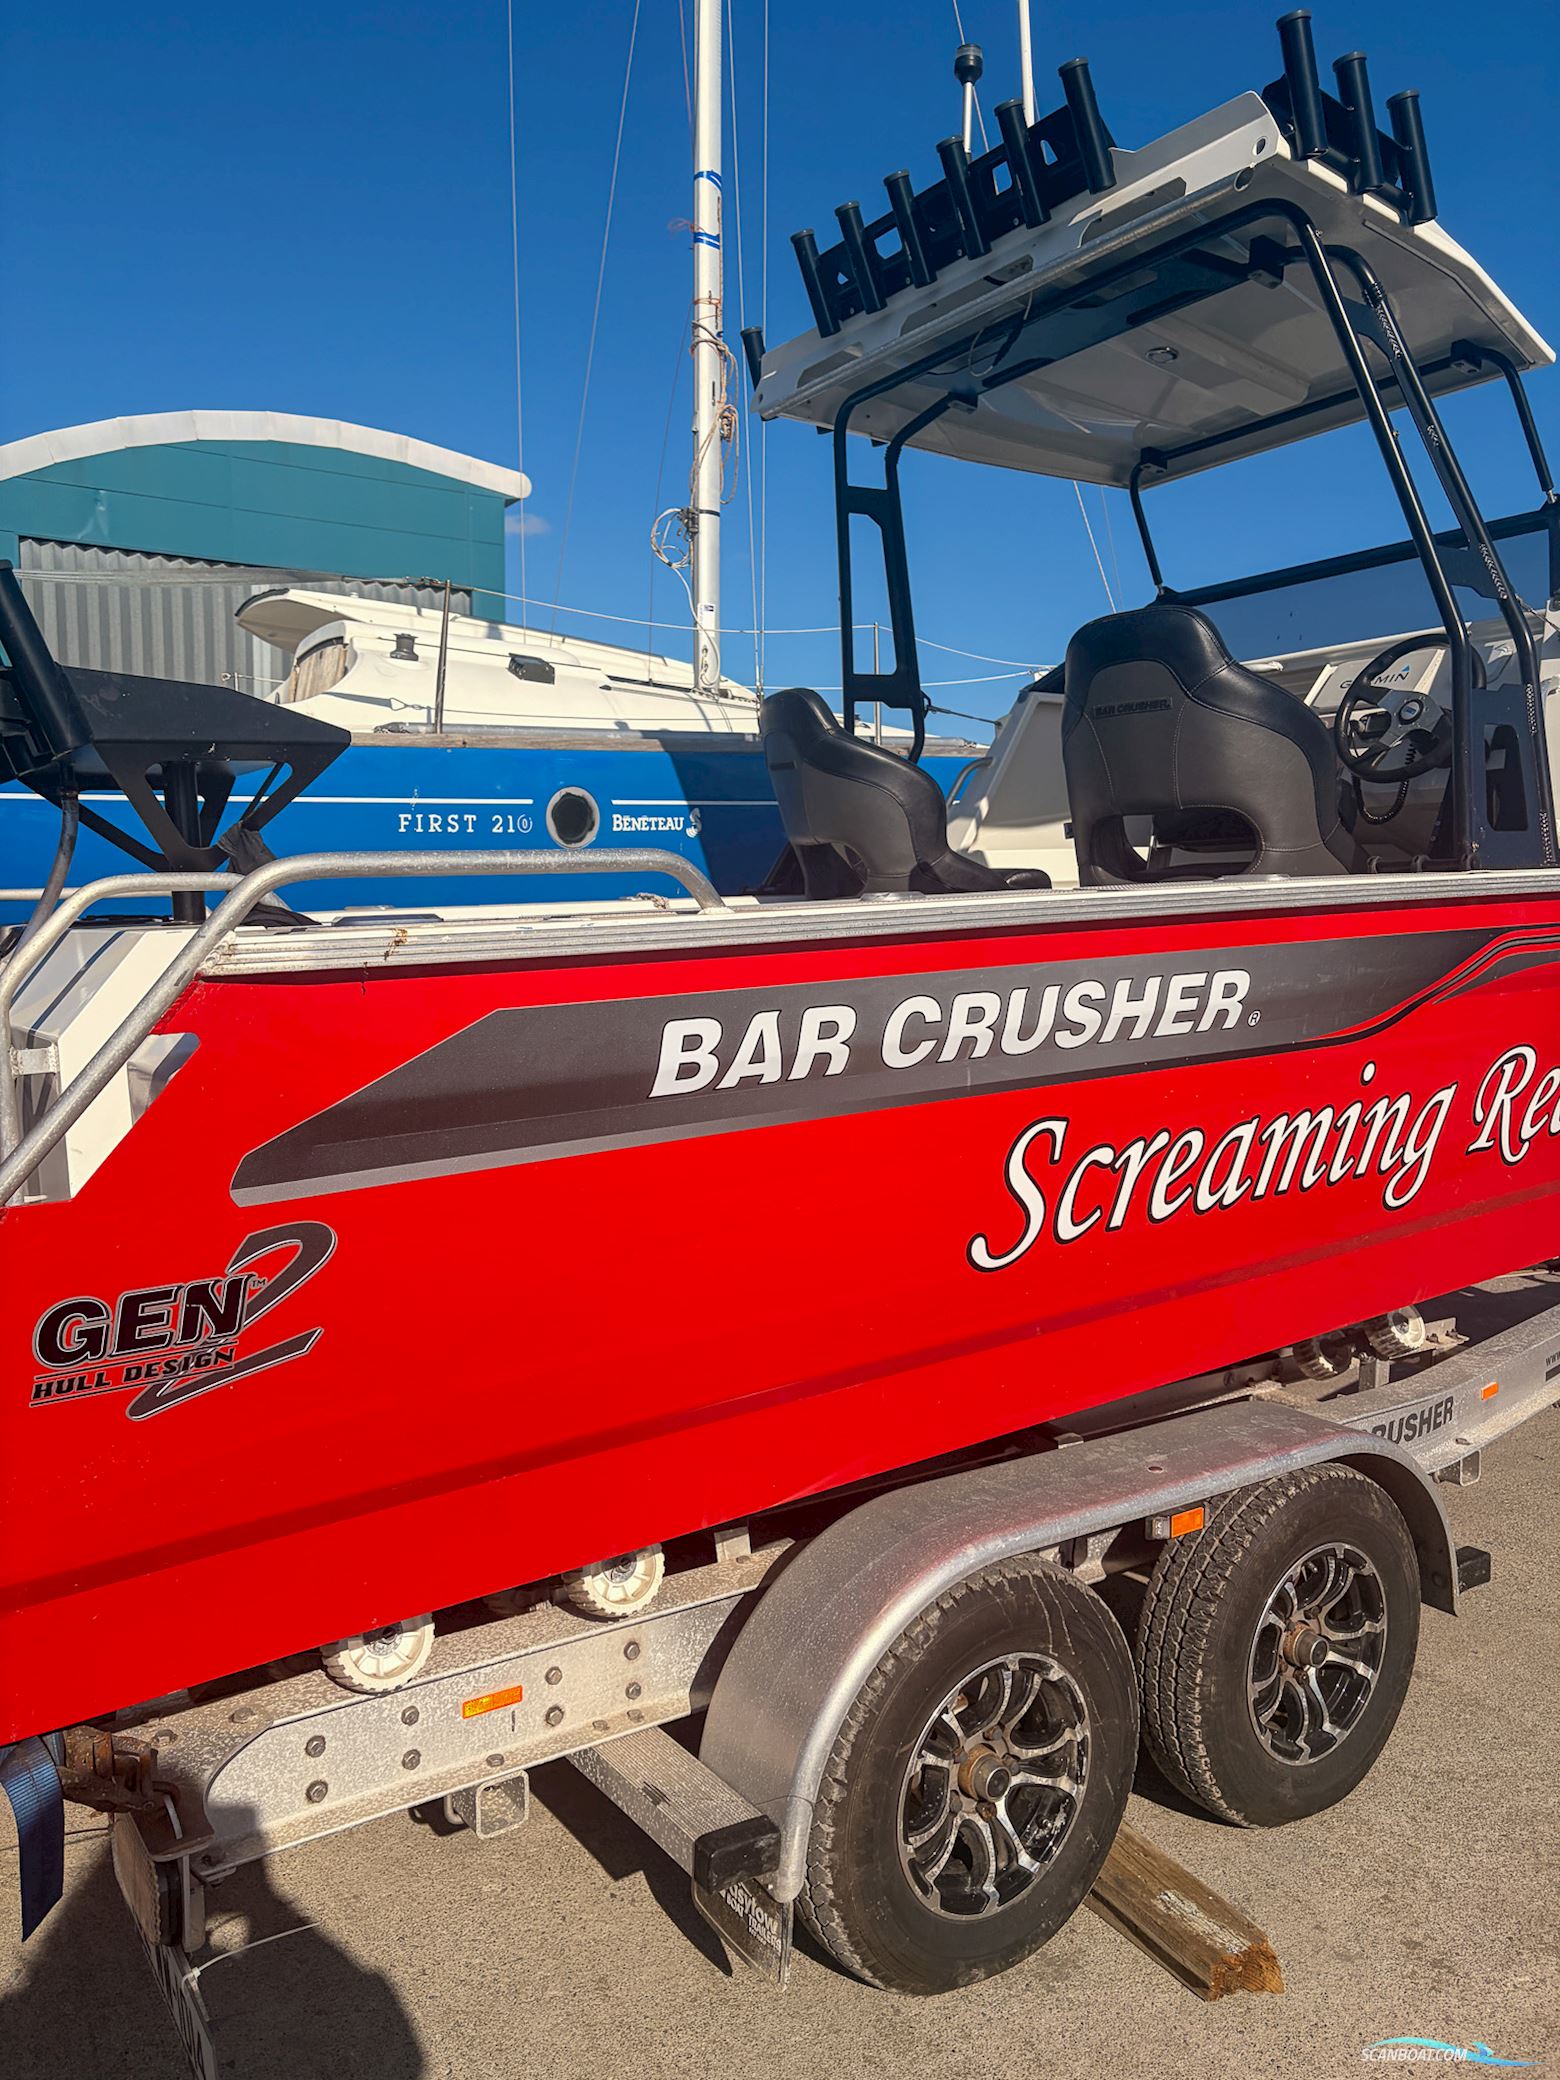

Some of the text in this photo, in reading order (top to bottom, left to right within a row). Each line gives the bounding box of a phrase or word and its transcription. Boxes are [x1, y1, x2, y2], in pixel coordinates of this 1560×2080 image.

[1340, 672, 1409, 689] GMIN
[398, 813, 477, 833] FIRST
[648, 1004, 858, 1099] BAR
[966, 1061, 1459, 1273] Screaming
[31, 1348, 235, 1401] HULL DESIGN
